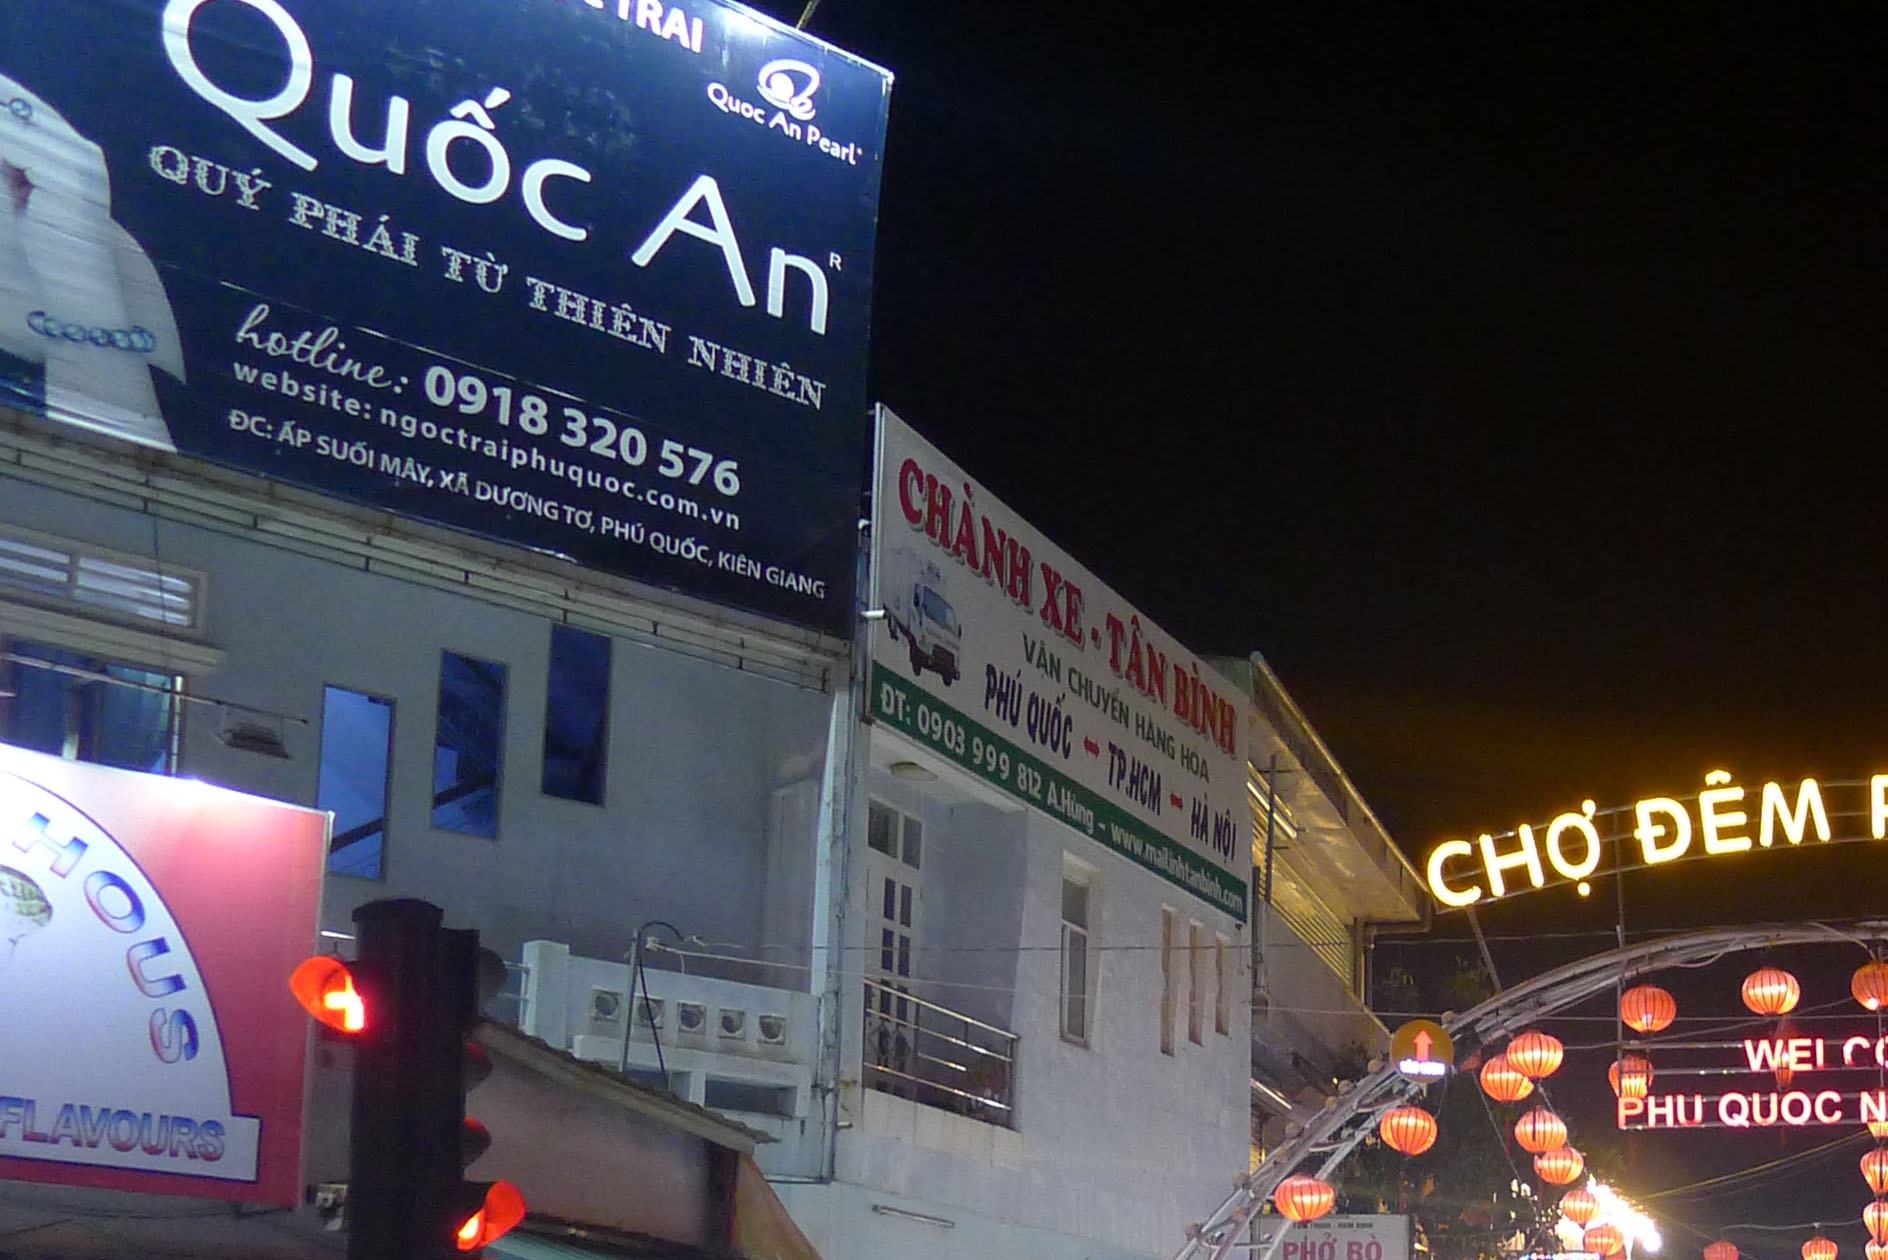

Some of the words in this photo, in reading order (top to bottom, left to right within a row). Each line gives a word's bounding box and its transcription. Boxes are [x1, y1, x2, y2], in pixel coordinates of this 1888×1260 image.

[163, 0, 592, 242] Quốc
[631, 173, 829, 336] An
[707, 82, 765, 125] Quoc
[768, 111, 802, 140] An
[806, 125, 857, 165] Pearl
[149, 145, 272, 211] QUÝ
[288, 191, 420, 267] PHÁI
[525, 276, 672, 354] THIÊN
[687, 335, 827, 411] NHIÊN
[232, 361, 372, 420] website:
[379, 407, 741, 531] ngoctraiphuquoc.com.vn
[235, 303, 409, 394] hotline:
[424, 365, 549, 437] 0918
[559, 406, 648, 467] 320
[657, 438, 741, 497] 576
[228, 408, 274, 439] ĐC:
[315, 434, 375, 469] SUỐI
[474, 480, 560, 521] DƯƠNG
[600, 515, 646, 544] PHÚ
[649, 531, 714, 569] QUỐC,
[718, 551, 762, 580] KIÊN
[765, 565, 826, 600] GIANG
[880, 681, 912, 726] ĐT:
[917, 704, 966, 756] 0903
[971, 736, 1011, 781] 999
[1016, 762, 1043, 801] 812
[1039, 562, 1085, 647] XE
[1105, 612, 1166, 706] TÂN
[1173, 661, 1237, 756] BÌNH
[984, 663, 1023, 728] PHÚ
[1026, 692, 1073, 760] QUỐC
[1107, 740, 1162, 817] TP.HCM
[1190, 792, 1209, 846] HÀ
[1426, 798, 1601, 908] CHỢ
[1633, 768, 1831, 865] ĐÊM
[0, 1095, 227, 1162] FLAVOURS
[1617, 1095, 1703, 1129] PHU
[1718, 1091, 1843, 1128] QUOC
